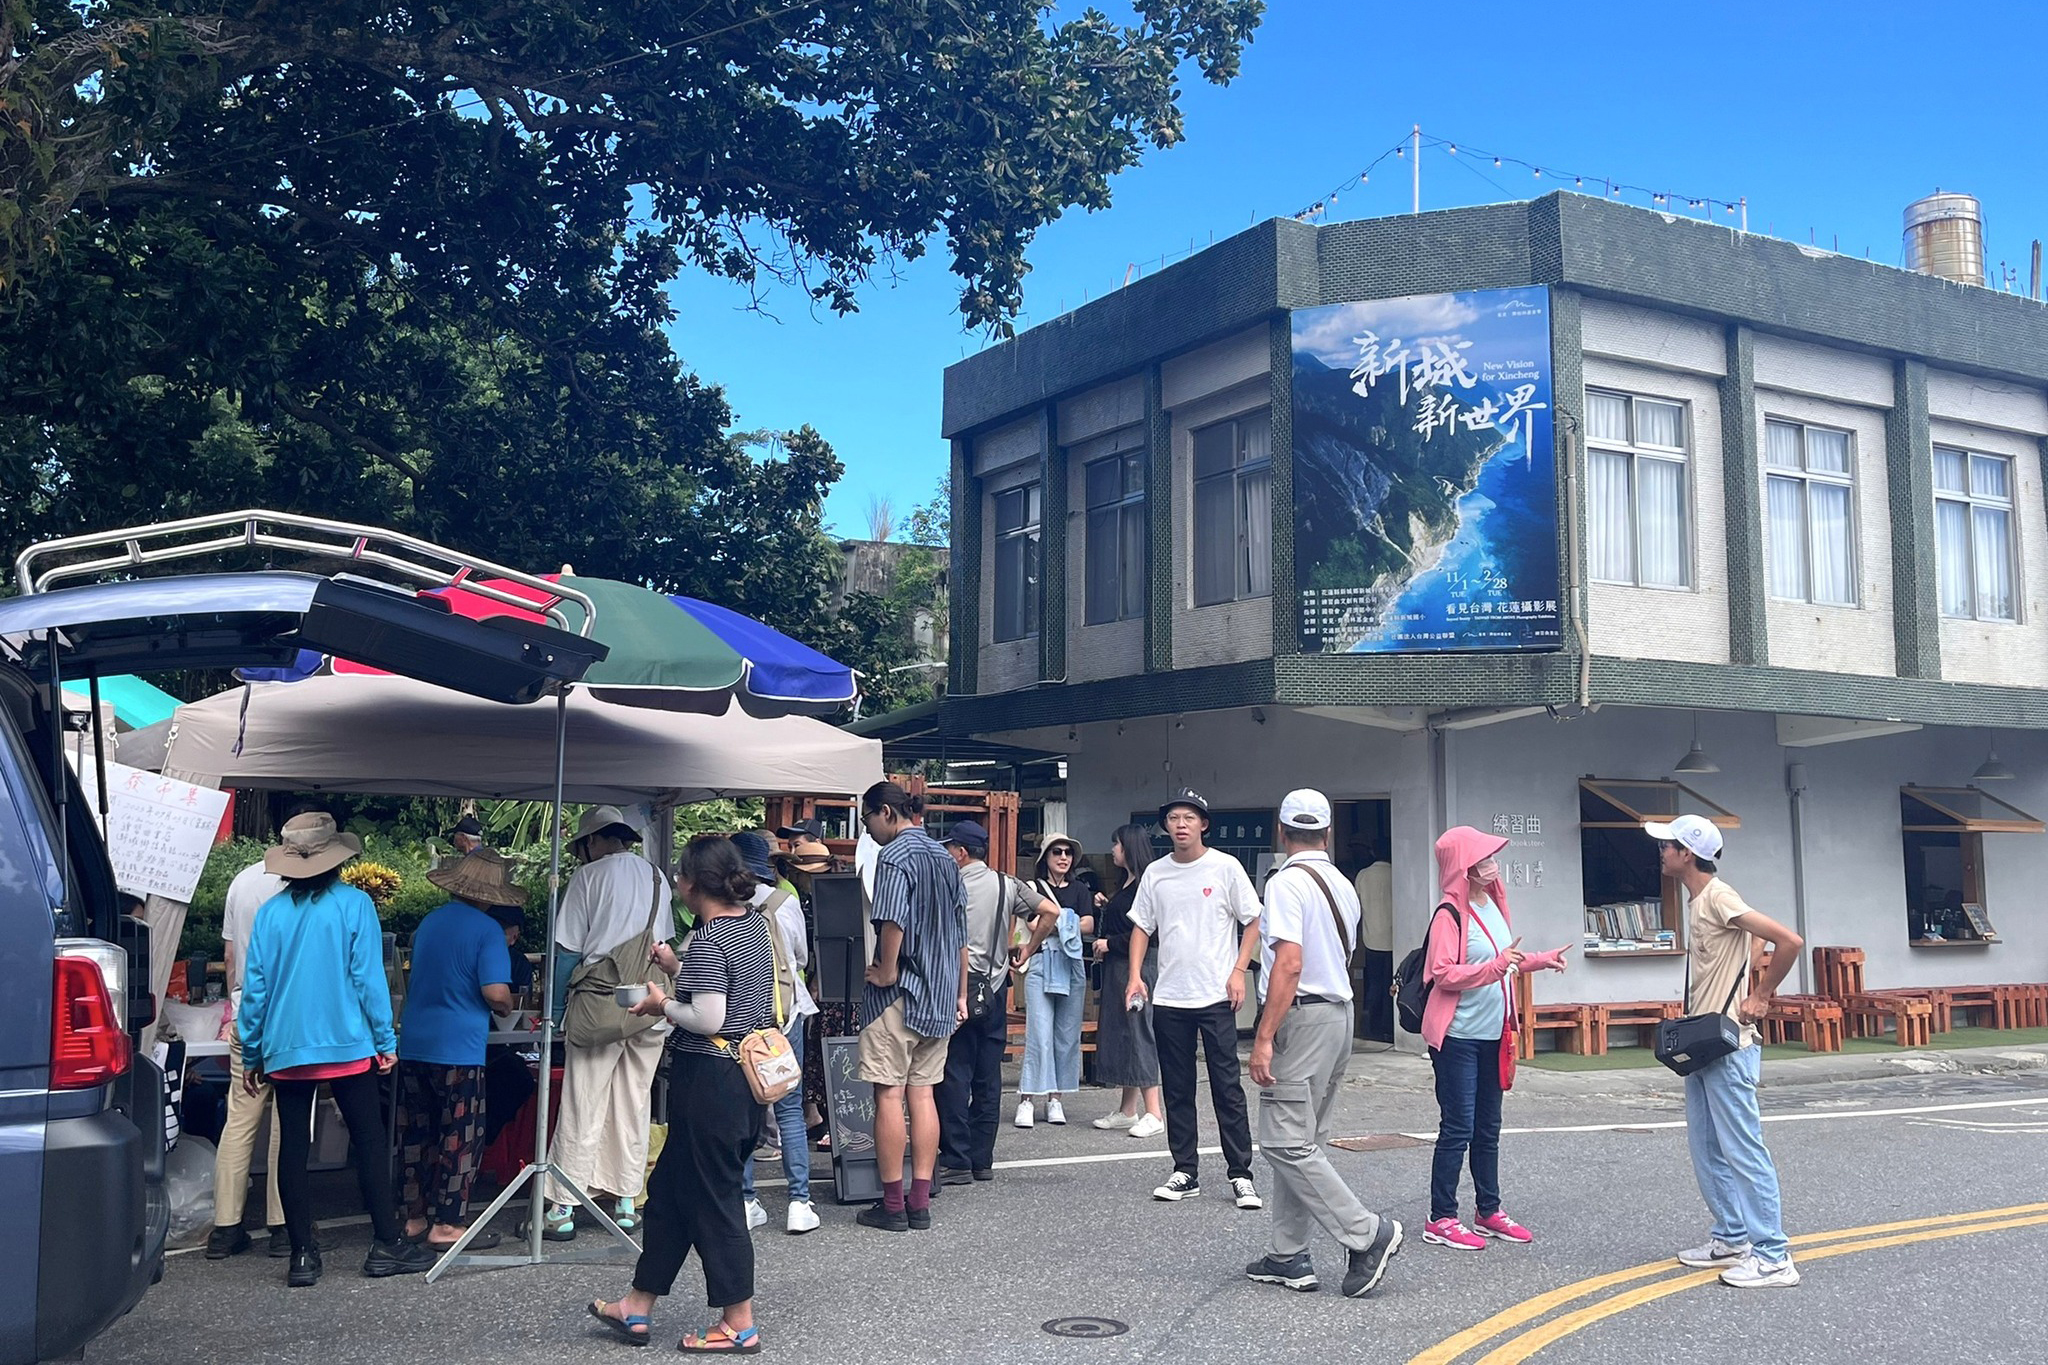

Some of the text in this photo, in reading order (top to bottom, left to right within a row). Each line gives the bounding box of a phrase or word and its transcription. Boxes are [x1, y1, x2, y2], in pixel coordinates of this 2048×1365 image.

[1350, 330, 1478, 406] 新城
[1483, 360, 1535, 371] New Vision
[1482, 370, 1540, 382] for Xincheng
[1412, 384, 1547, 473] 新世界
[1446, 600, 1558, 615] 看見台灣 花蓮攝影展
[1493, 813, 1541, 834] 練習曲
